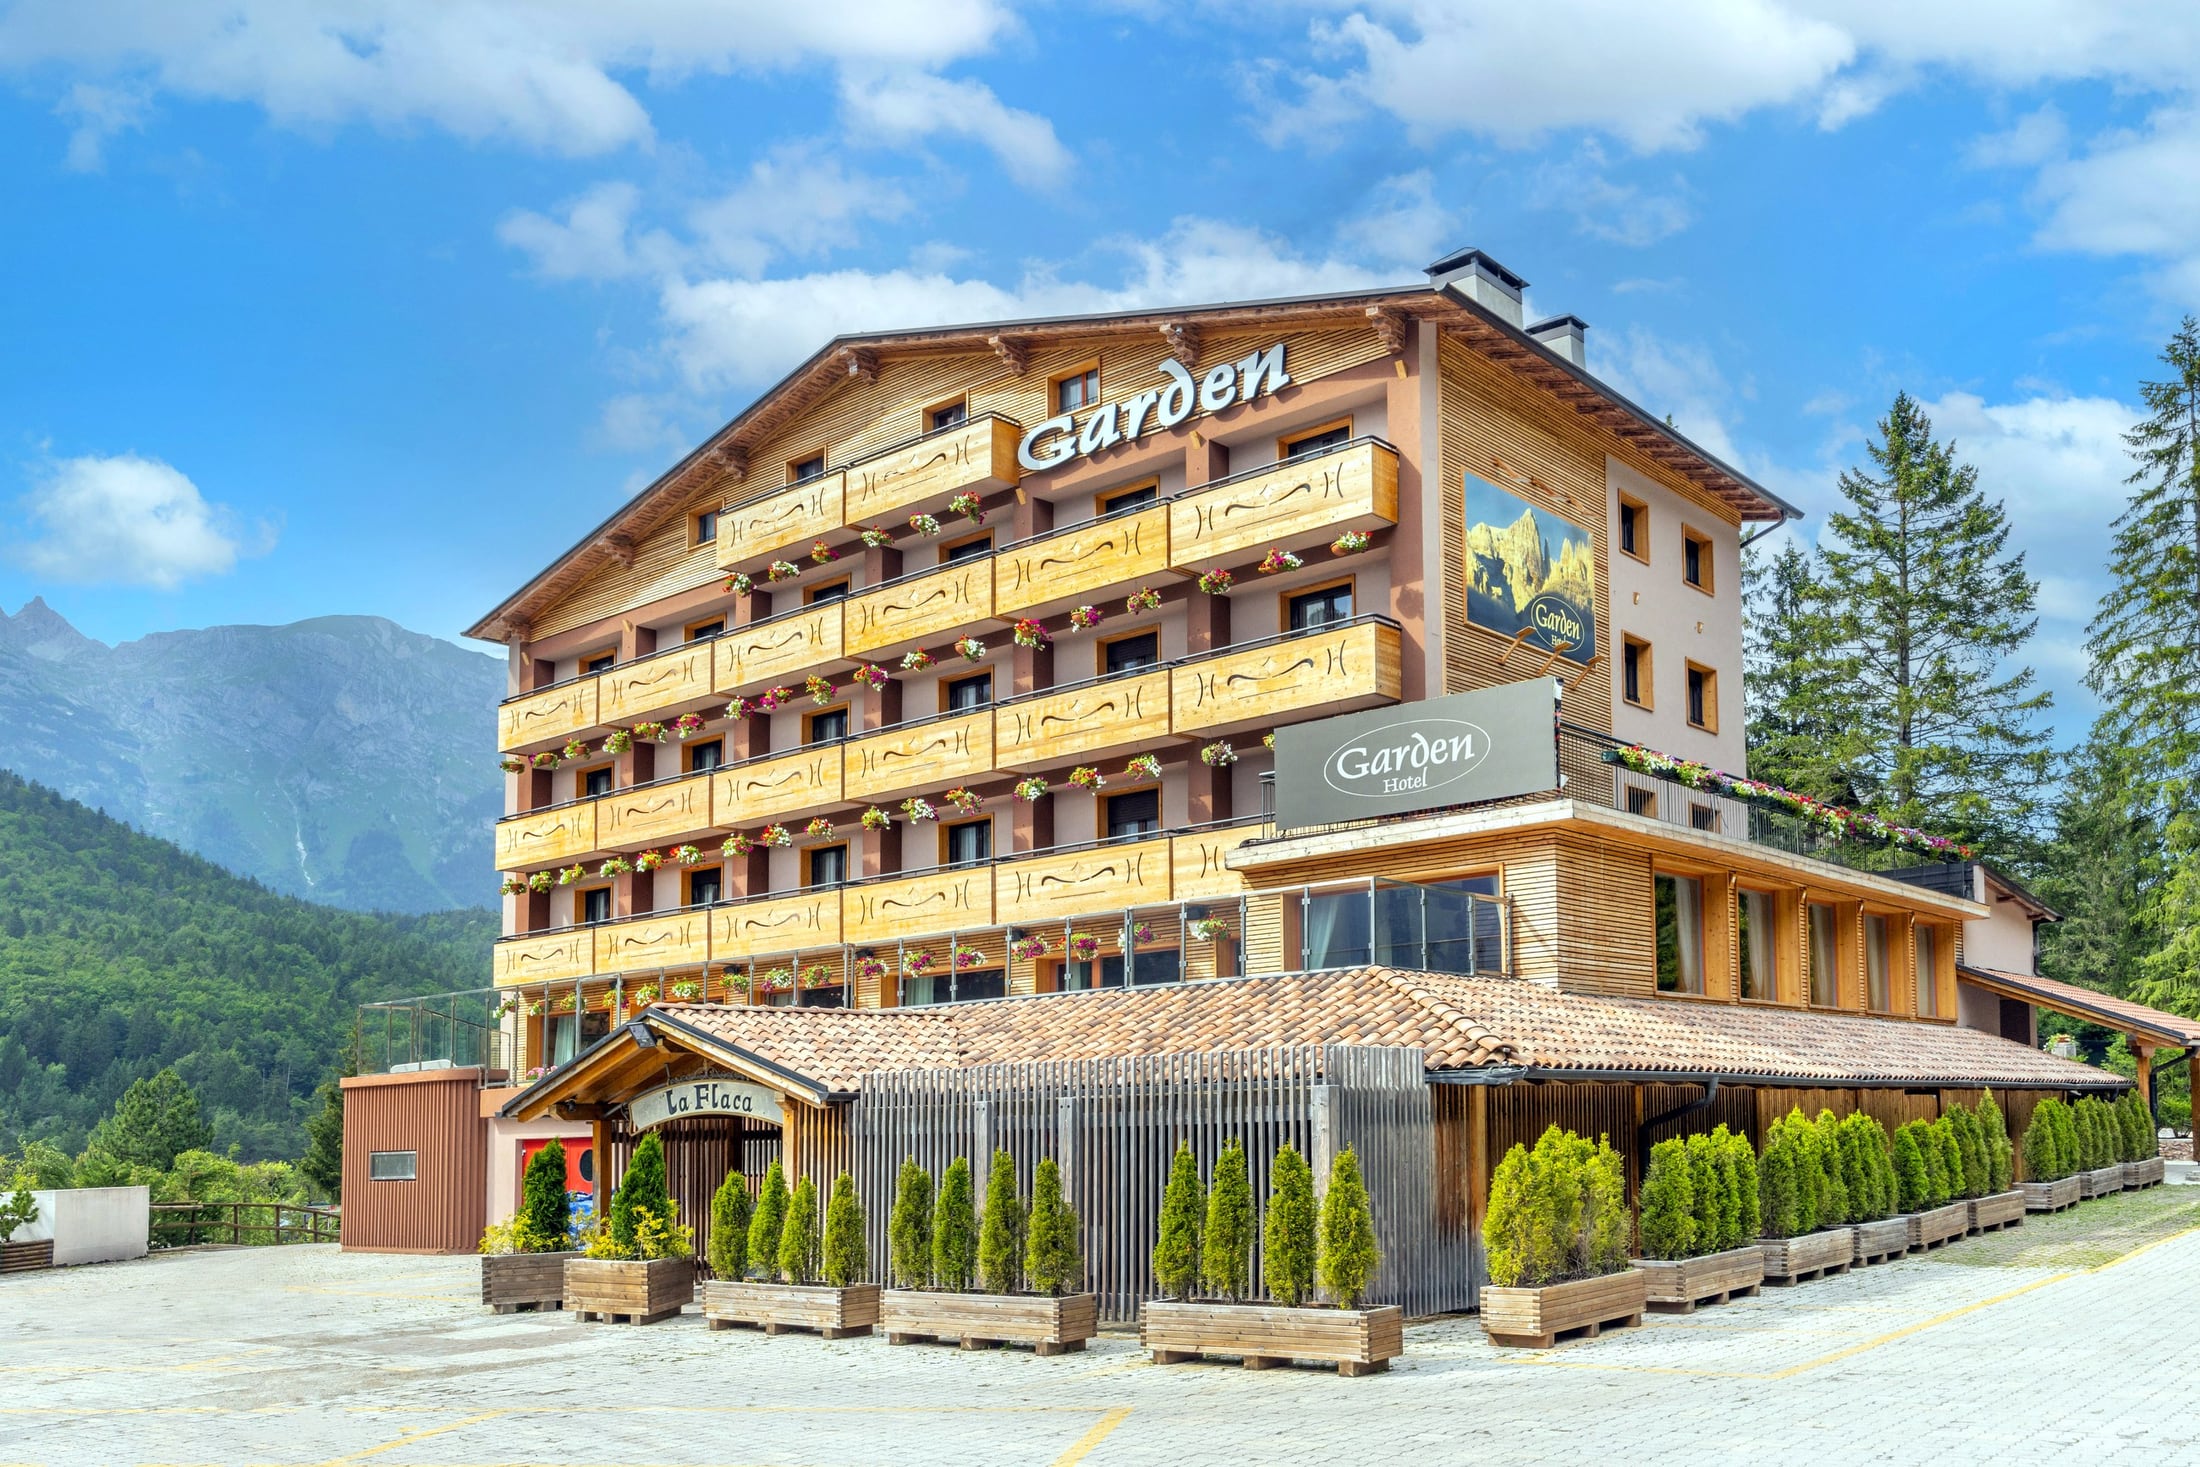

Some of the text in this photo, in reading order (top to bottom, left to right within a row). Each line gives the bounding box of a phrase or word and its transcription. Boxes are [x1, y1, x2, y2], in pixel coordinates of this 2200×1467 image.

[1018, 343, 1291, 470] Garden
[1535, 604, 1580, 640] Garden
[1336, 733, 1475, 779] Garden
[1383, 767, 1428, 793] Hotel
[694, 1083, 753, 1113] Flaca
